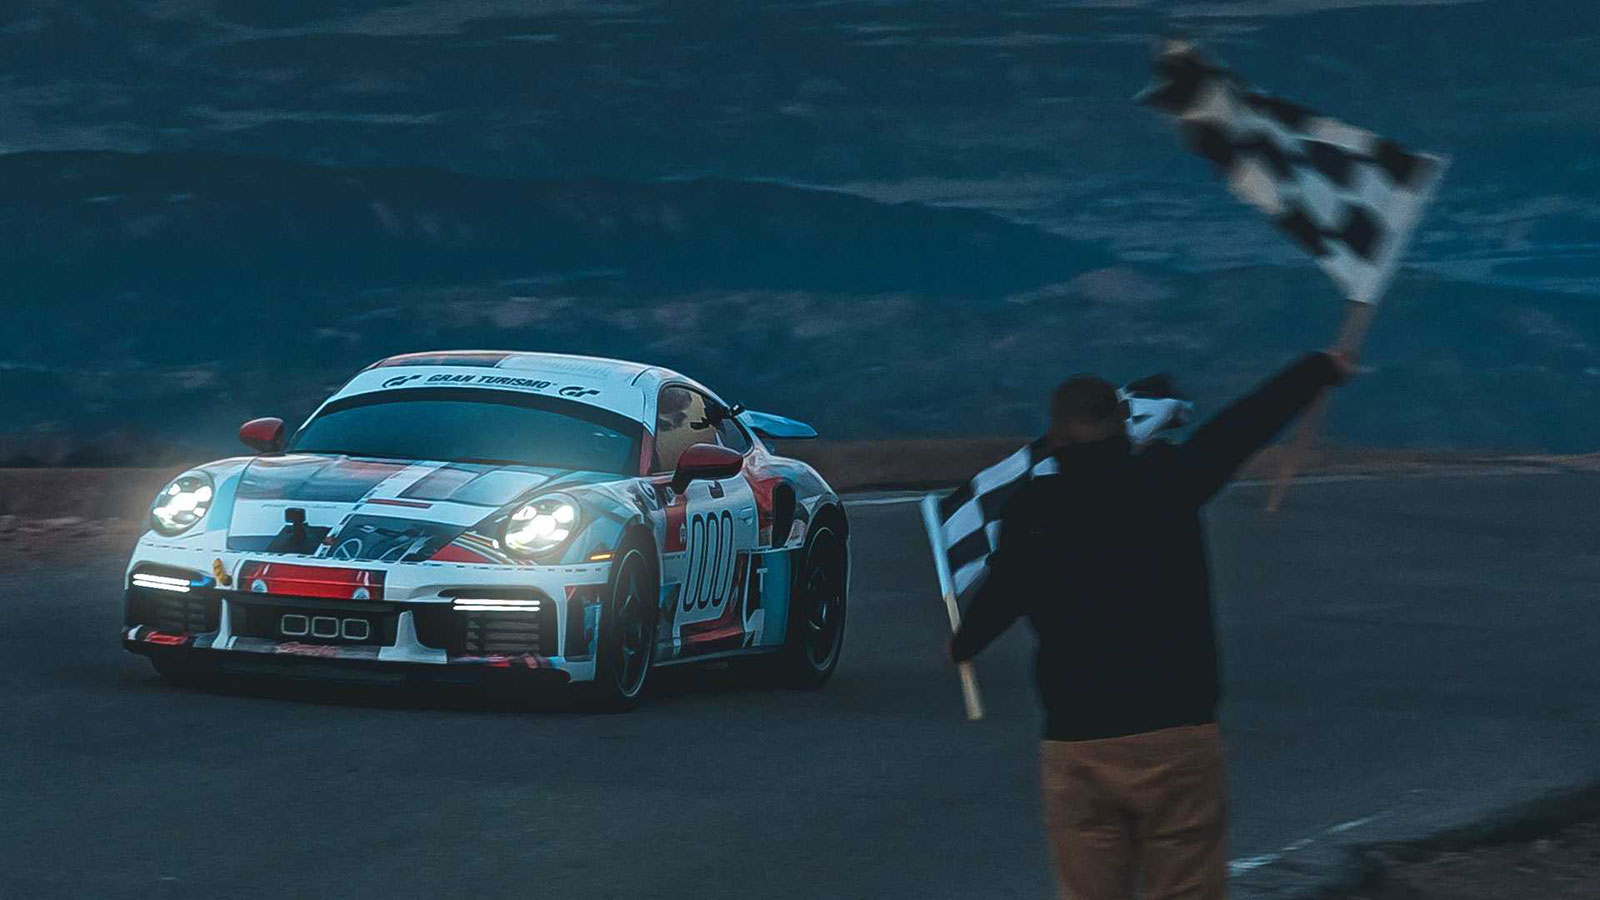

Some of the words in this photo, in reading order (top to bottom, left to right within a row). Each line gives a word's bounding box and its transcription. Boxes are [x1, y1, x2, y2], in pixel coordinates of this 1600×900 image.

[427, 374, 476, 382] GRAN
[477, 375, 552, 389] TURISMO
[682, 509, 735, 612] 000
